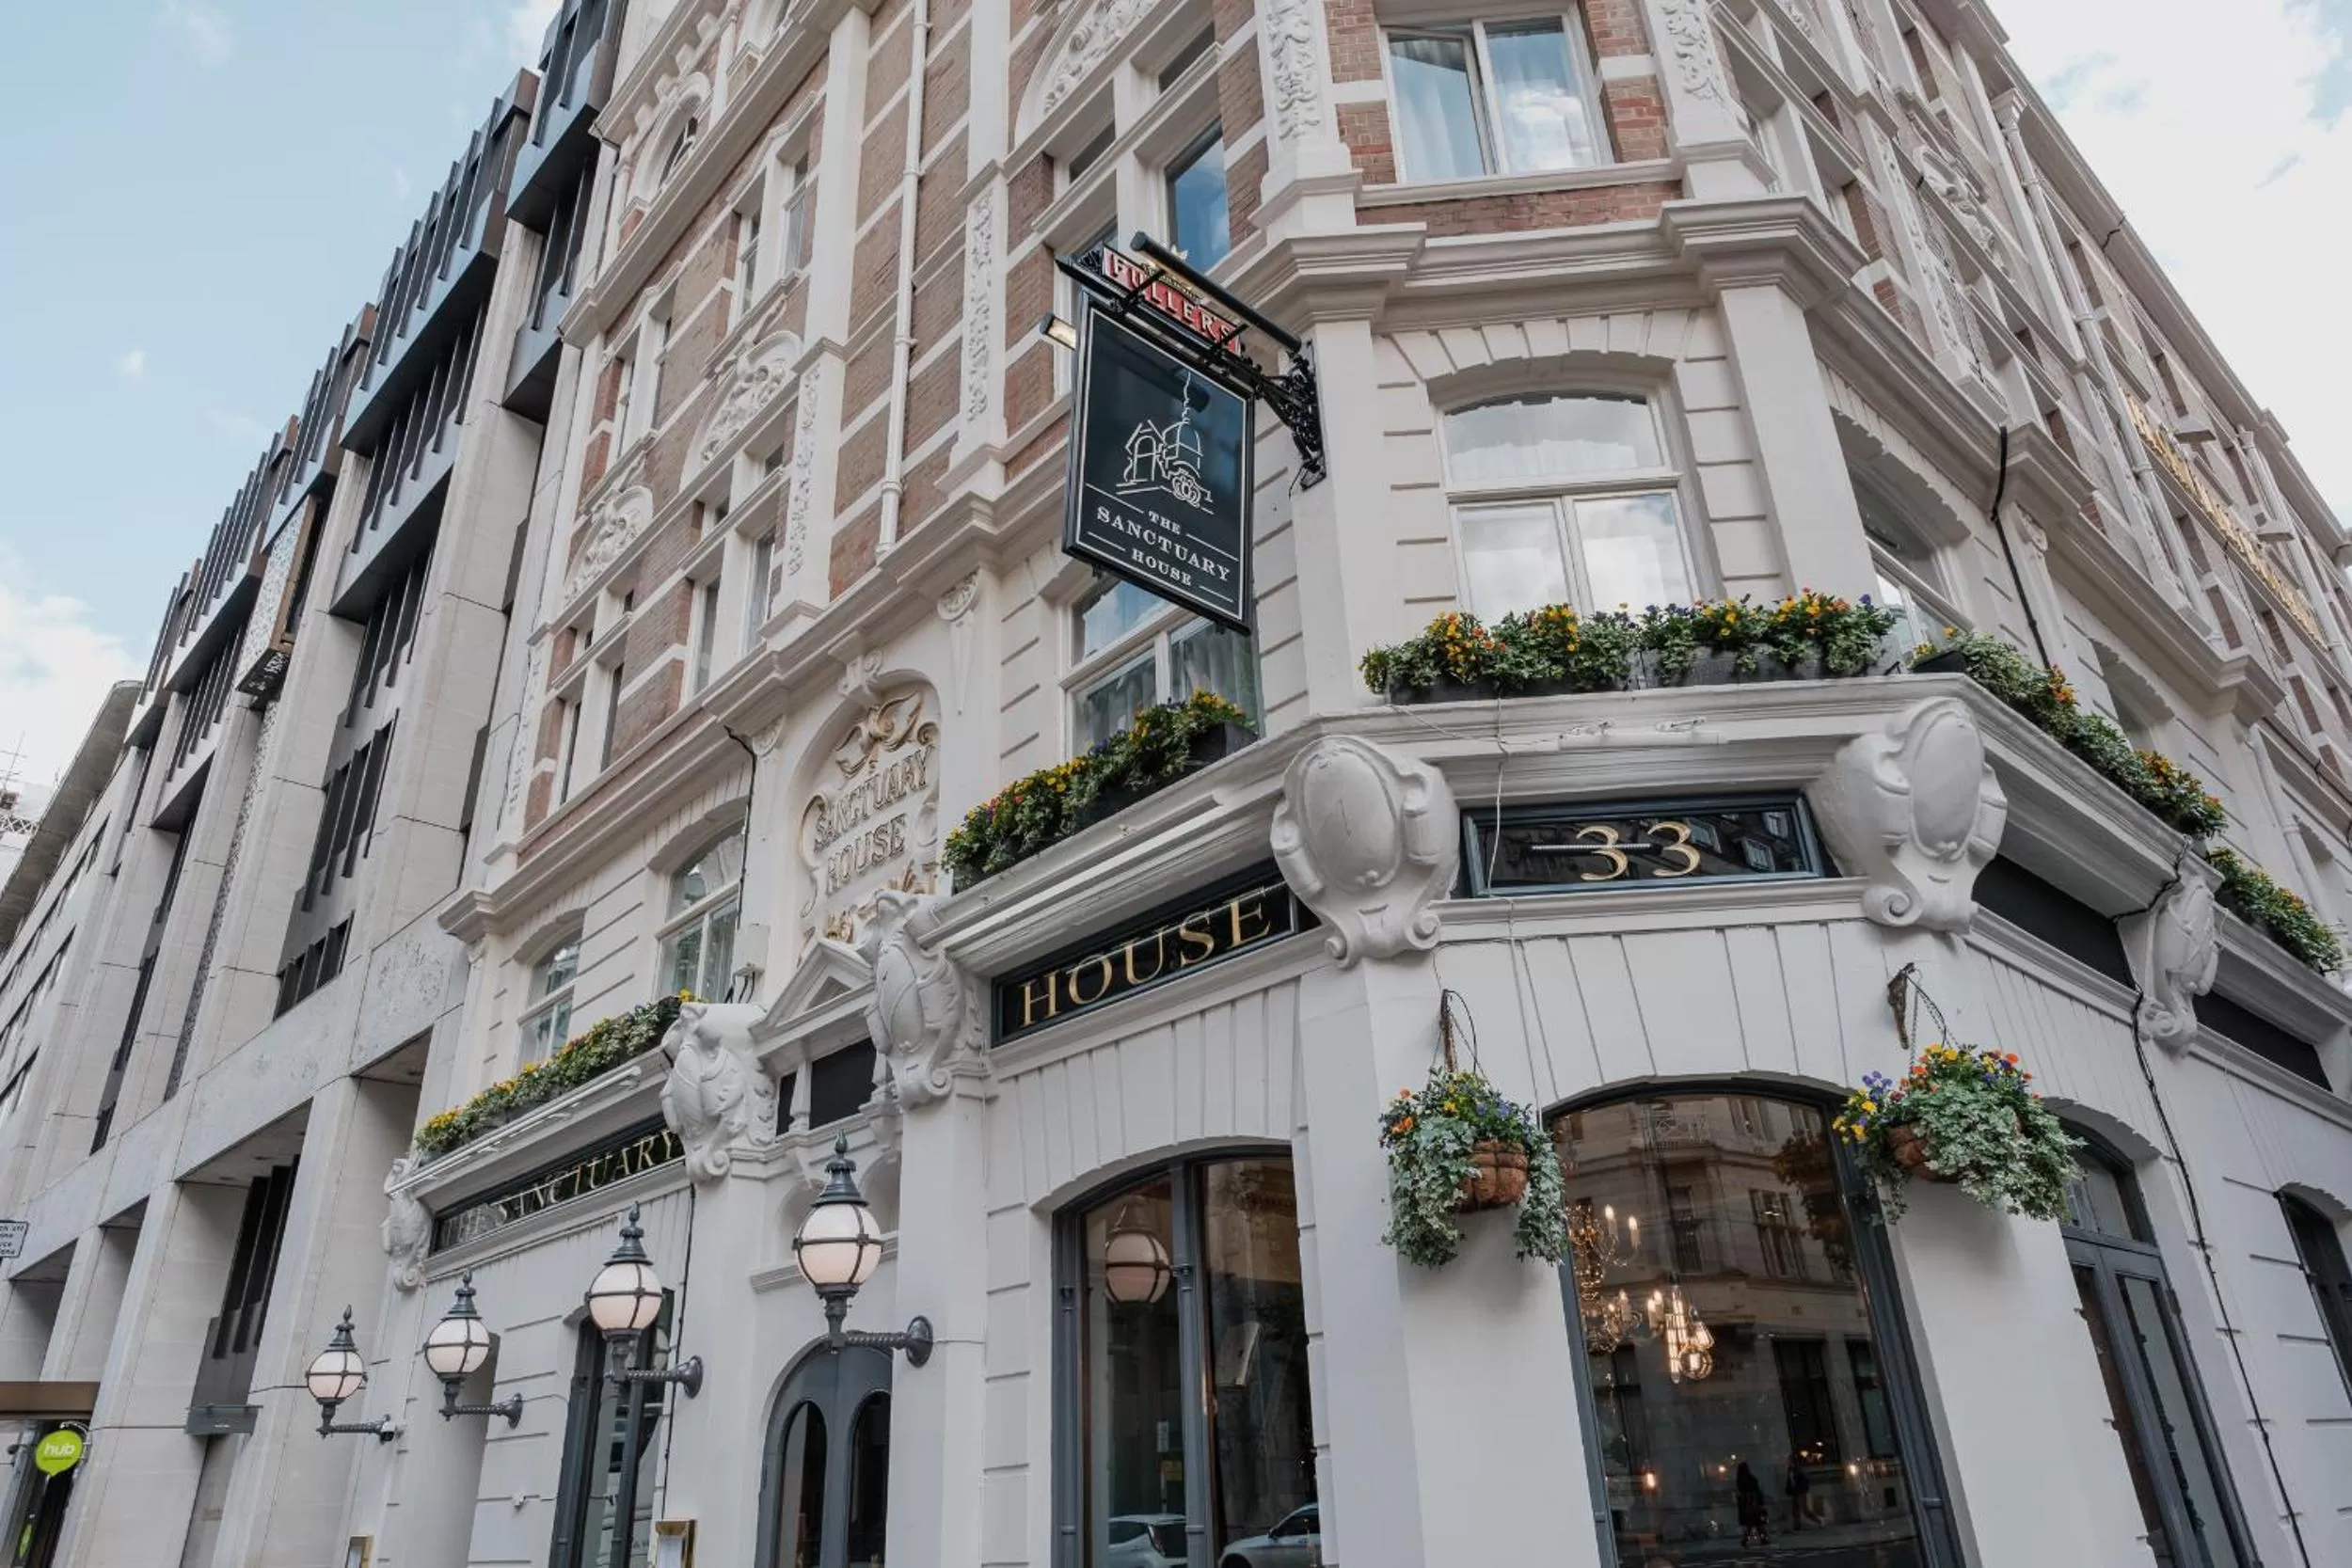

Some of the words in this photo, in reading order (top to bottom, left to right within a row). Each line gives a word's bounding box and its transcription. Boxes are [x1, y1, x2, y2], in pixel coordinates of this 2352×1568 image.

[1096, 505, 1231, 582] SANCTUARY
[1149, 510, 1183, 535] THE
[1132, 547, 1192, 587] HOUSE
[815, 747, 934, 849] SANCTUARY
[825, 814, 908, 894] HOUSE
[1576, 821, 1700, 880] 33
[1019, 886, 1271, 1027] HOUSE
[44, 1442, 75, 1457] hub
